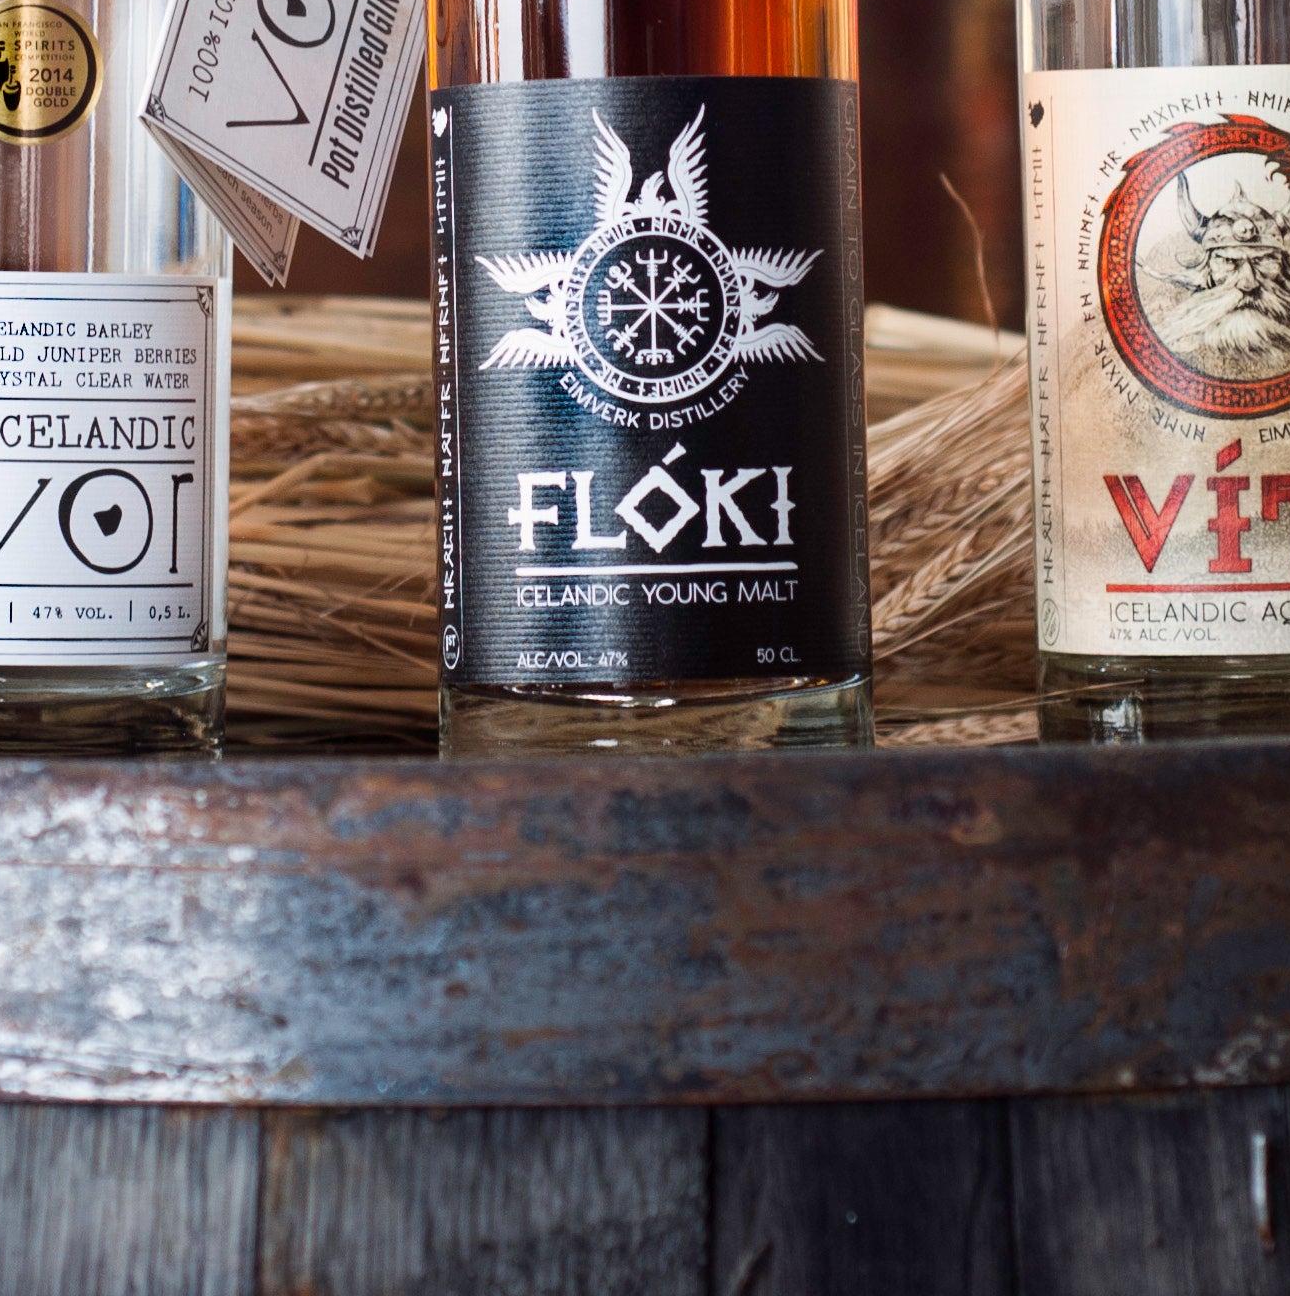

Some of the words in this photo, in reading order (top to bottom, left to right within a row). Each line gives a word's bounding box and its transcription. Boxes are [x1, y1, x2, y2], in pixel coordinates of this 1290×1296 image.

[14, 40, 76, 52] SPIRITS
[14, 54, 76, 62] COMPETITION
[189, 30, 220, 103] 100%
[29, 68, 74, 82] 2014
[333, 26, 389, 144] Distilled
[25, 86, 76, 97] DOUBLE
[33, 98, 69, 108] GOLD
[320, 136, 359, 190] Pot
[844, 97, 859, 209] GRAIN
[241, 190, 274, 238] season.
[846, 231, 860, 280] TO
[86, 322, 154, 340] BARLEY
[38, 347, 123, 364] JUNIPER
[134, 348, 197, 365] BERRIES
[848, 301, 864, 427] GLASS
[76, 372, 133, 389] CLEAR
[144, 373, 190, 390] WATER
[559, 371, 640, 429] EIMVERK
[649, 365, 750, 430] DISTILLERY
[852, 444, 864, 476] IN
[509, 442, 796, 554] FLÓKI
[853, 493, 870, 657] ICELAND
[517, 584, 630, 607] ICELANDIC
[641, 582, 728, 605] YOUNG
[738, 580, 798, 602] MALT
[32, 606, 63, 619] 47%
[76, 607, 114, 620] VOL.
[149, 606, 172, 621] 0,5
[178, 606, 192, 619] L.
[1109, 601, 1247, 623] ICELANDIC
[1109, 628, 1132, 641] 47%
[598, 651, 628, 669] 47%
[757, 648, 775, 663] 50
[780, 647, 802, 662] CL.
